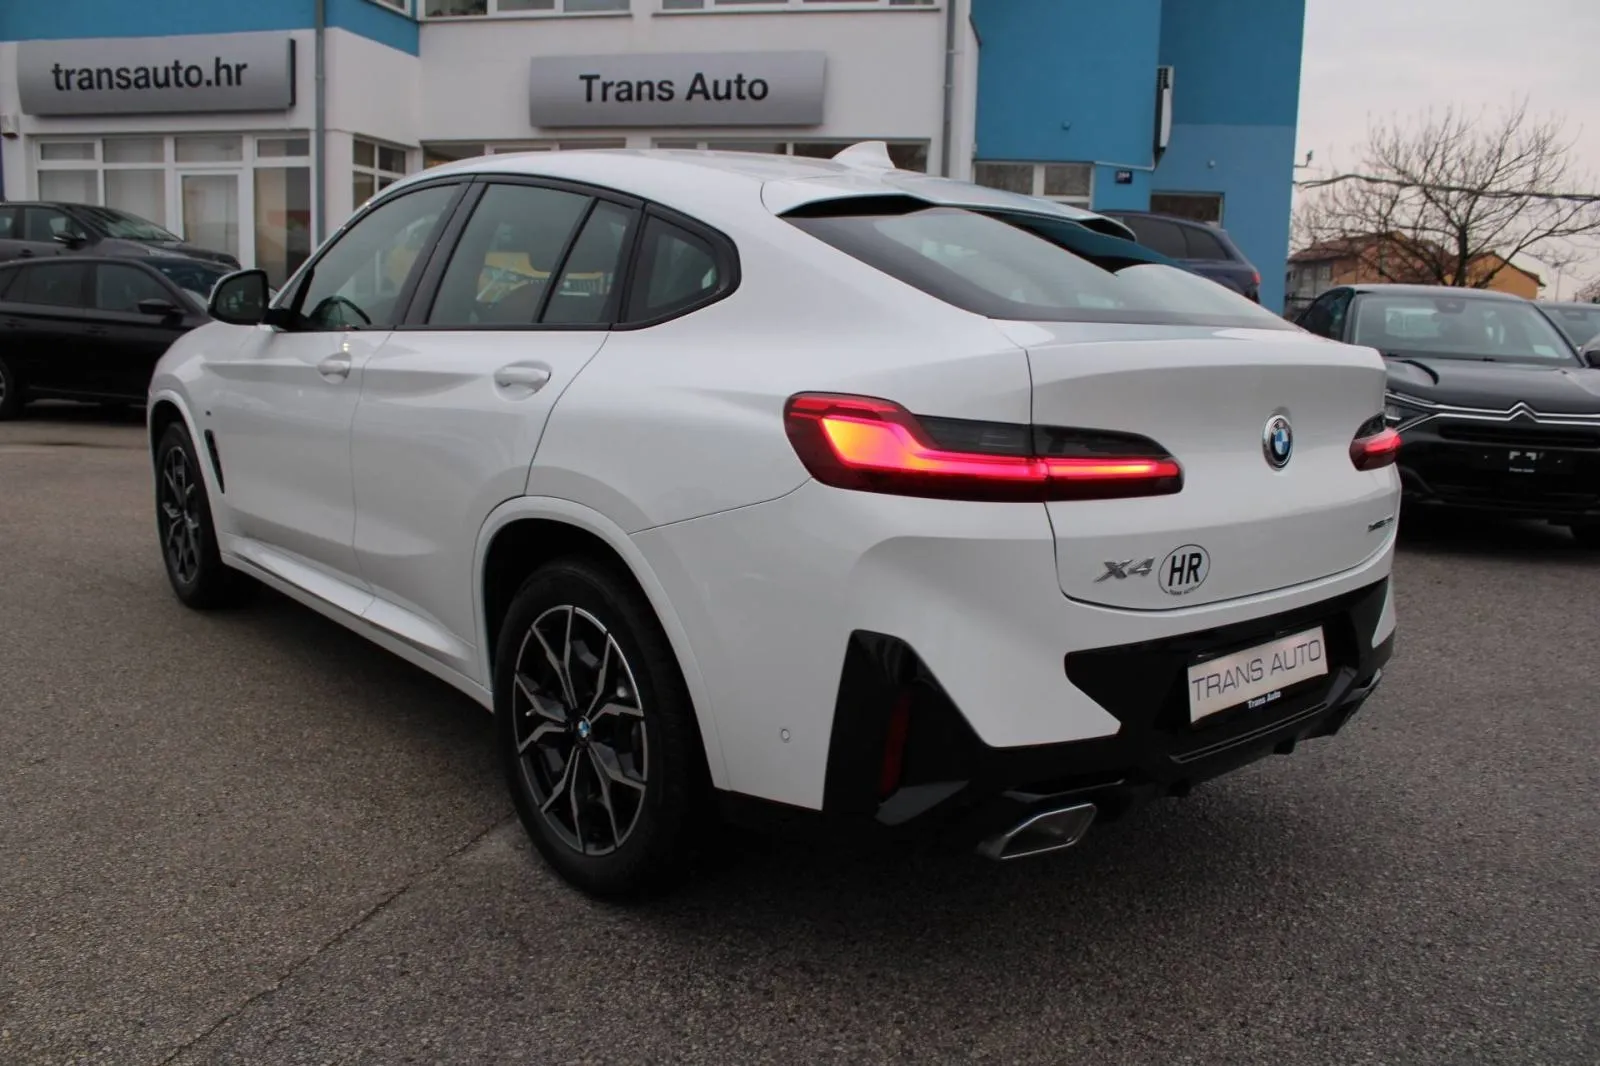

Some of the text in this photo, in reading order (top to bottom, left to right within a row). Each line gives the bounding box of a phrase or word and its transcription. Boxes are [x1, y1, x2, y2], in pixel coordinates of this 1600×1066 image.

[52, 57, 248, 91] transauto.hr
[579, 72, 769, 102] Trans Auto
[1094, 557, 1155, 583] X4
[1168, 552, 1202, 586] HR
[1192, 639, 1322, 701] TRANS AUTO
